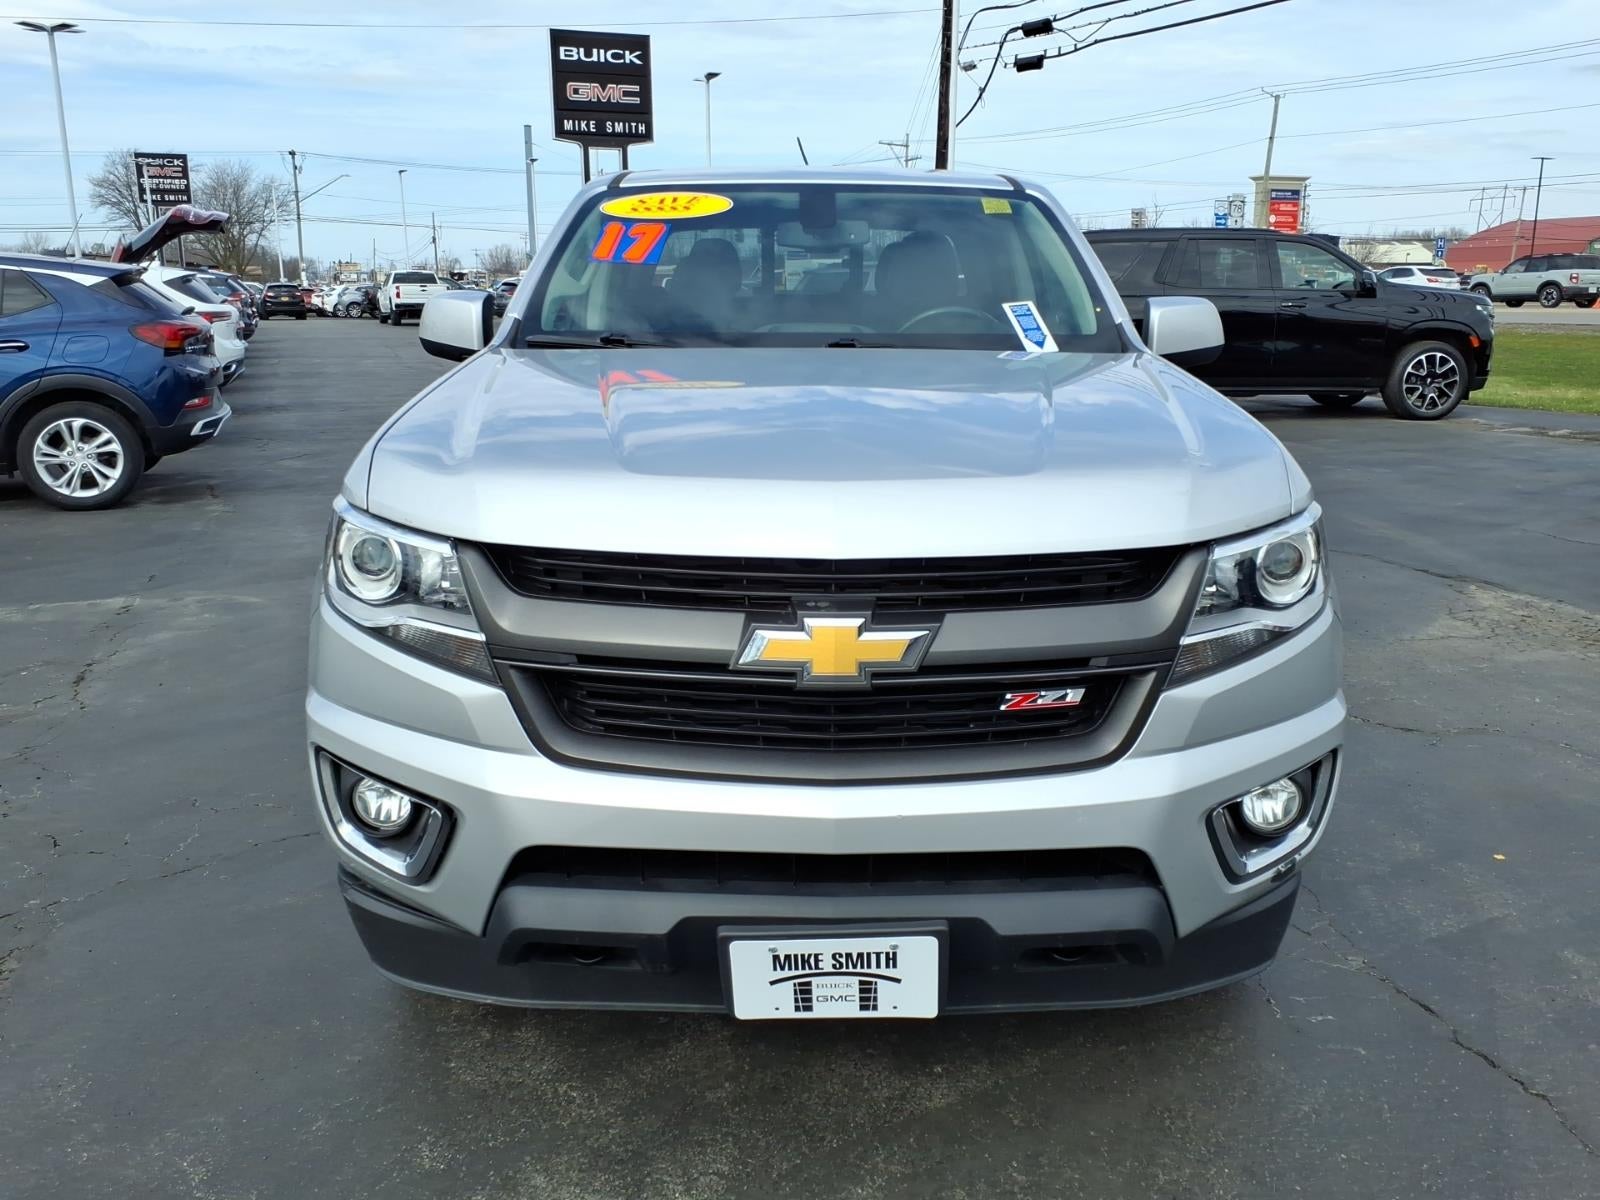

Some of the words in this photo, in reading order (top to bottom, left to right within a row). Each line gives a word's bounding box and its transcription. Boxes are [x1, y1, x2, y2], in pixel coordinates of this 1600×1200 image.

[559, 46, 643, 64] BUICK
[566, 81, 640, 104] GMC
[563, 119, 597, 132] MIKE
[606, 121, 646, 134] SMITH
[1233, 204, 1242, 213] 78
[592, 221, 667, 264] 17
[1438, 239, 1445, 248] H
[1000, 688, 1086, 711] Z71
[771, 952, 824, 972] MIKE
[831, 951, 898, 971] SMITH
[816, 994, 857, 1003] GMC
